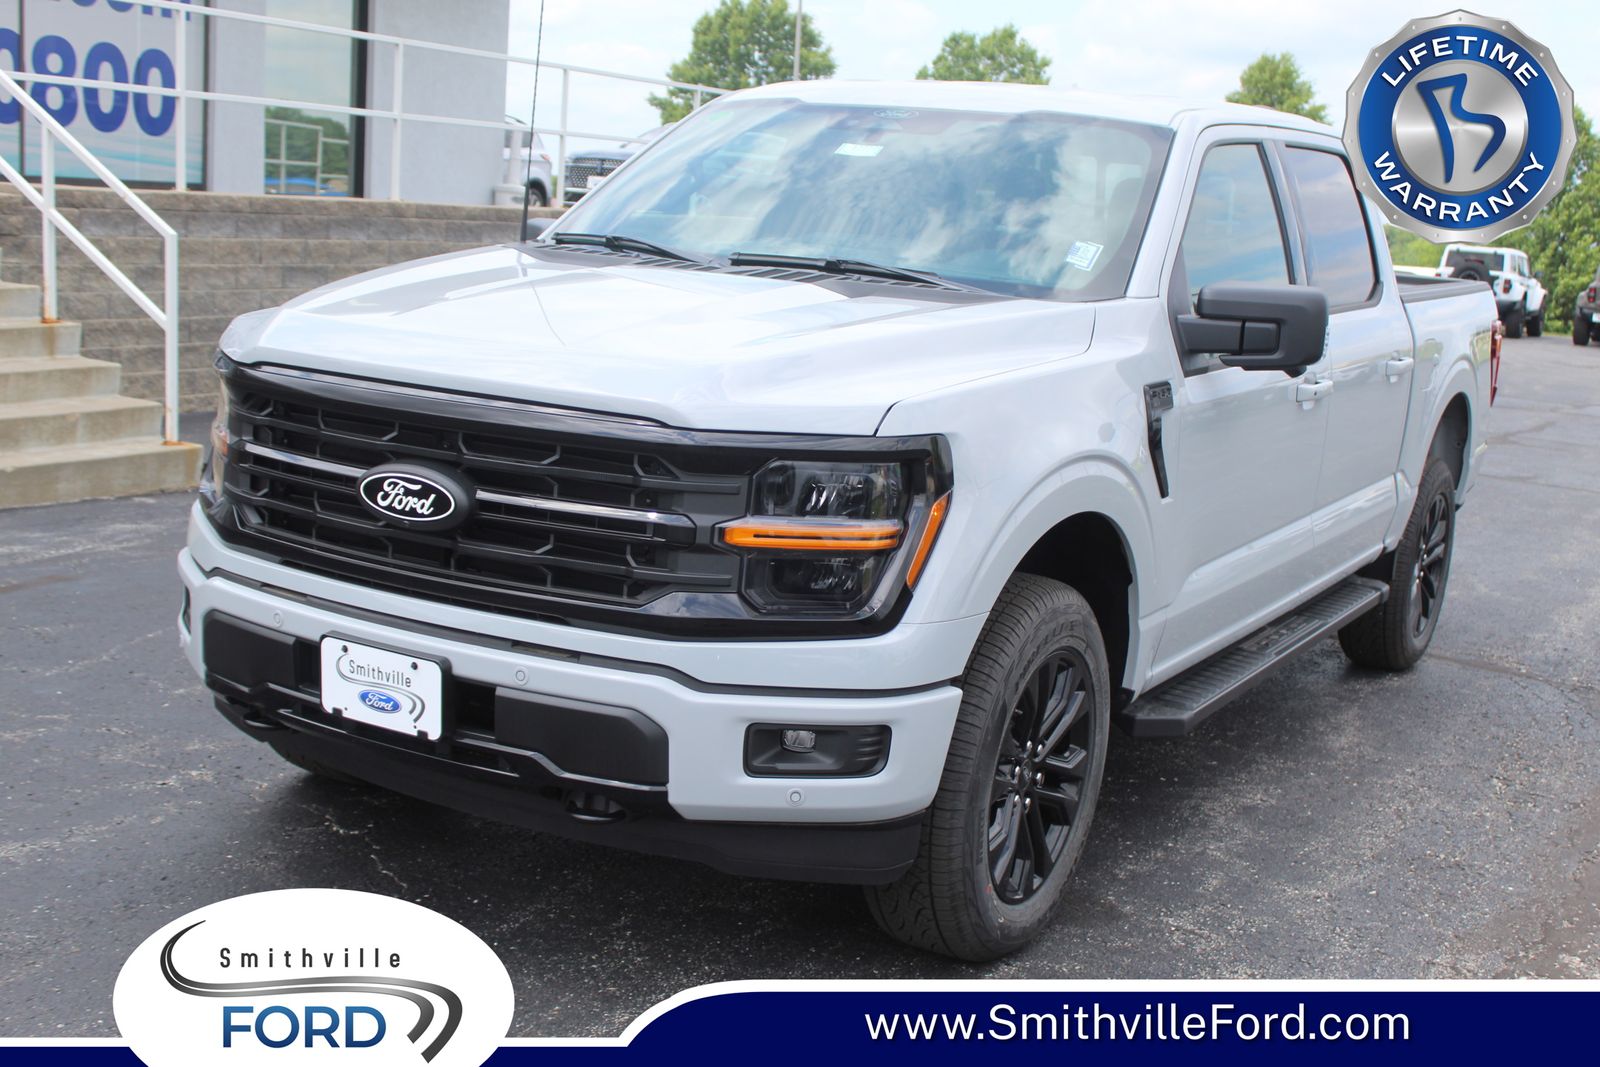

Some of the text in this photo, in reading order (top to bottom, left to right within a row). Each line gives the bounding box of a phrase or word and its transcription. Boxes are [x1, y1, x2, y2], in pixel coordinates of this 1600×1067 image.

[376, 478, 436, 515] Ford
[348, 659, 412, 688] Smithville
[365, 691, 395, 711] Ford
